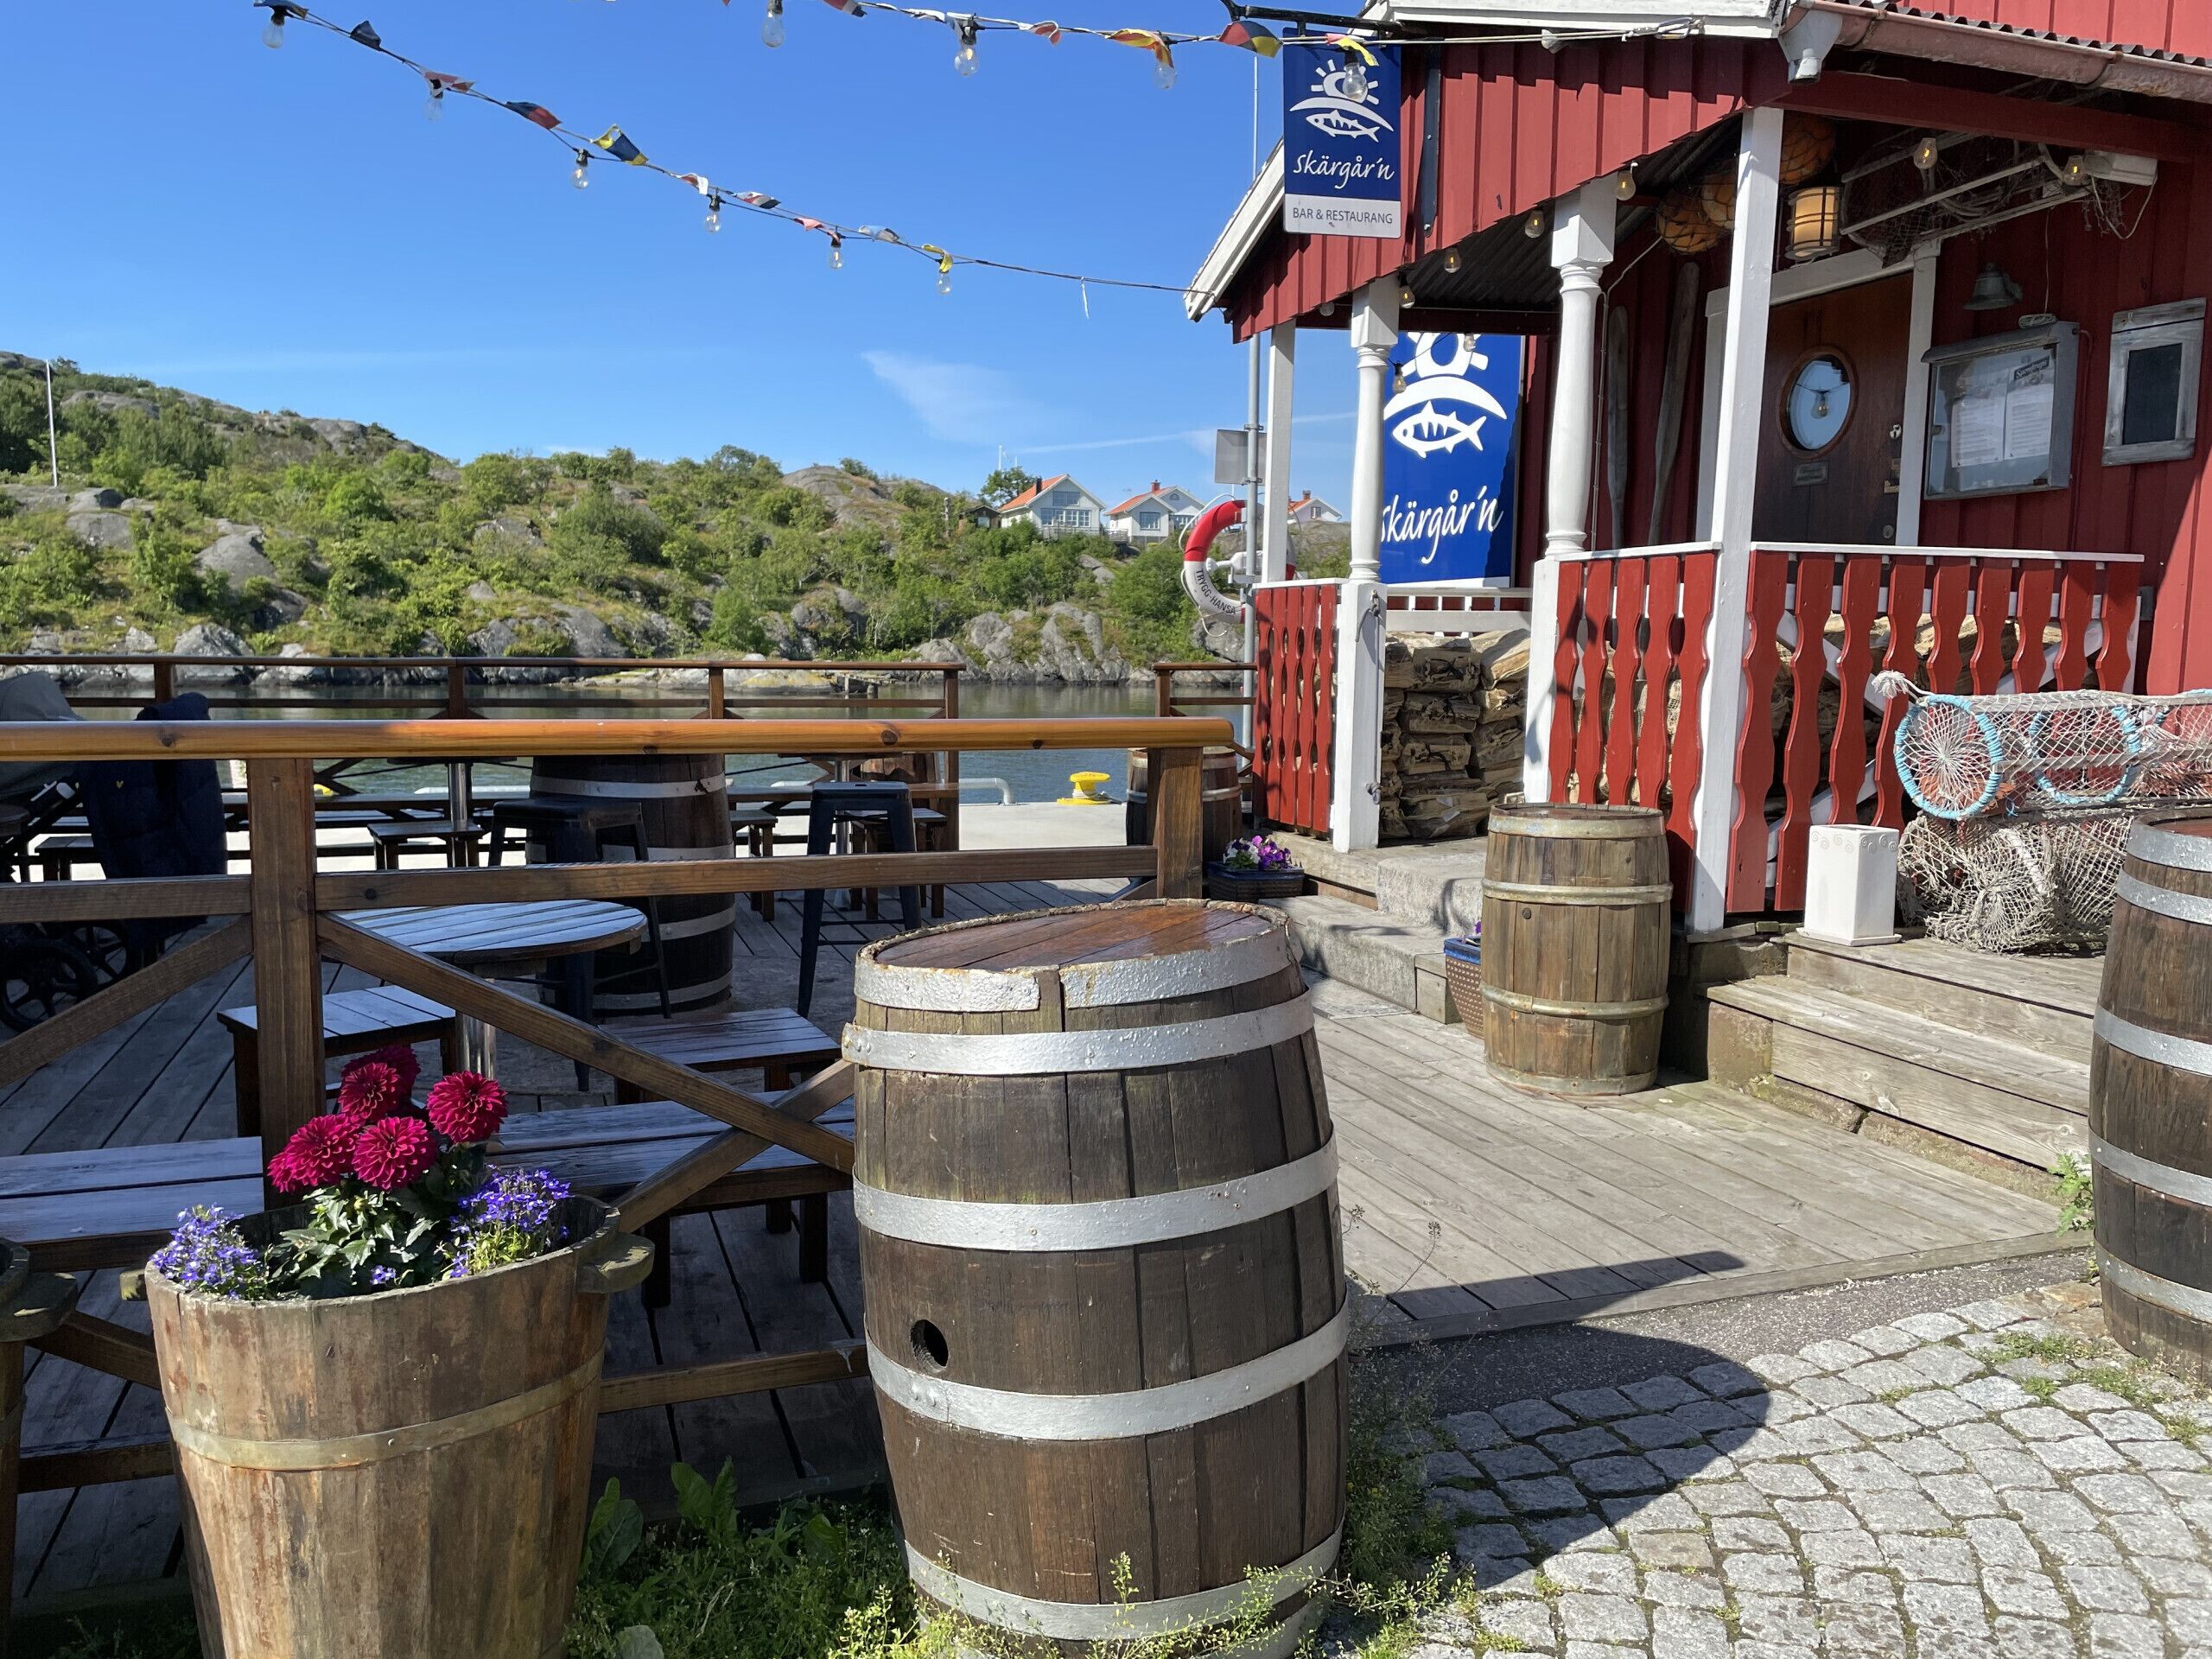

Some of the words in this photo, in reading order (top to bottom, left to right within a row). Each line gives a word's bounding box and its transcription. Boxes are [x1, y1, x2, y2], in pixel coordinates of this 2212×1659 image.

[1293, 207, 1313, 219] BAR
[1316, 209, 1324, 220] &
[1326, 209, 1393, 224] RESTAURANG
[1196, 569, 1236, 614] TRYGG-HANSA
